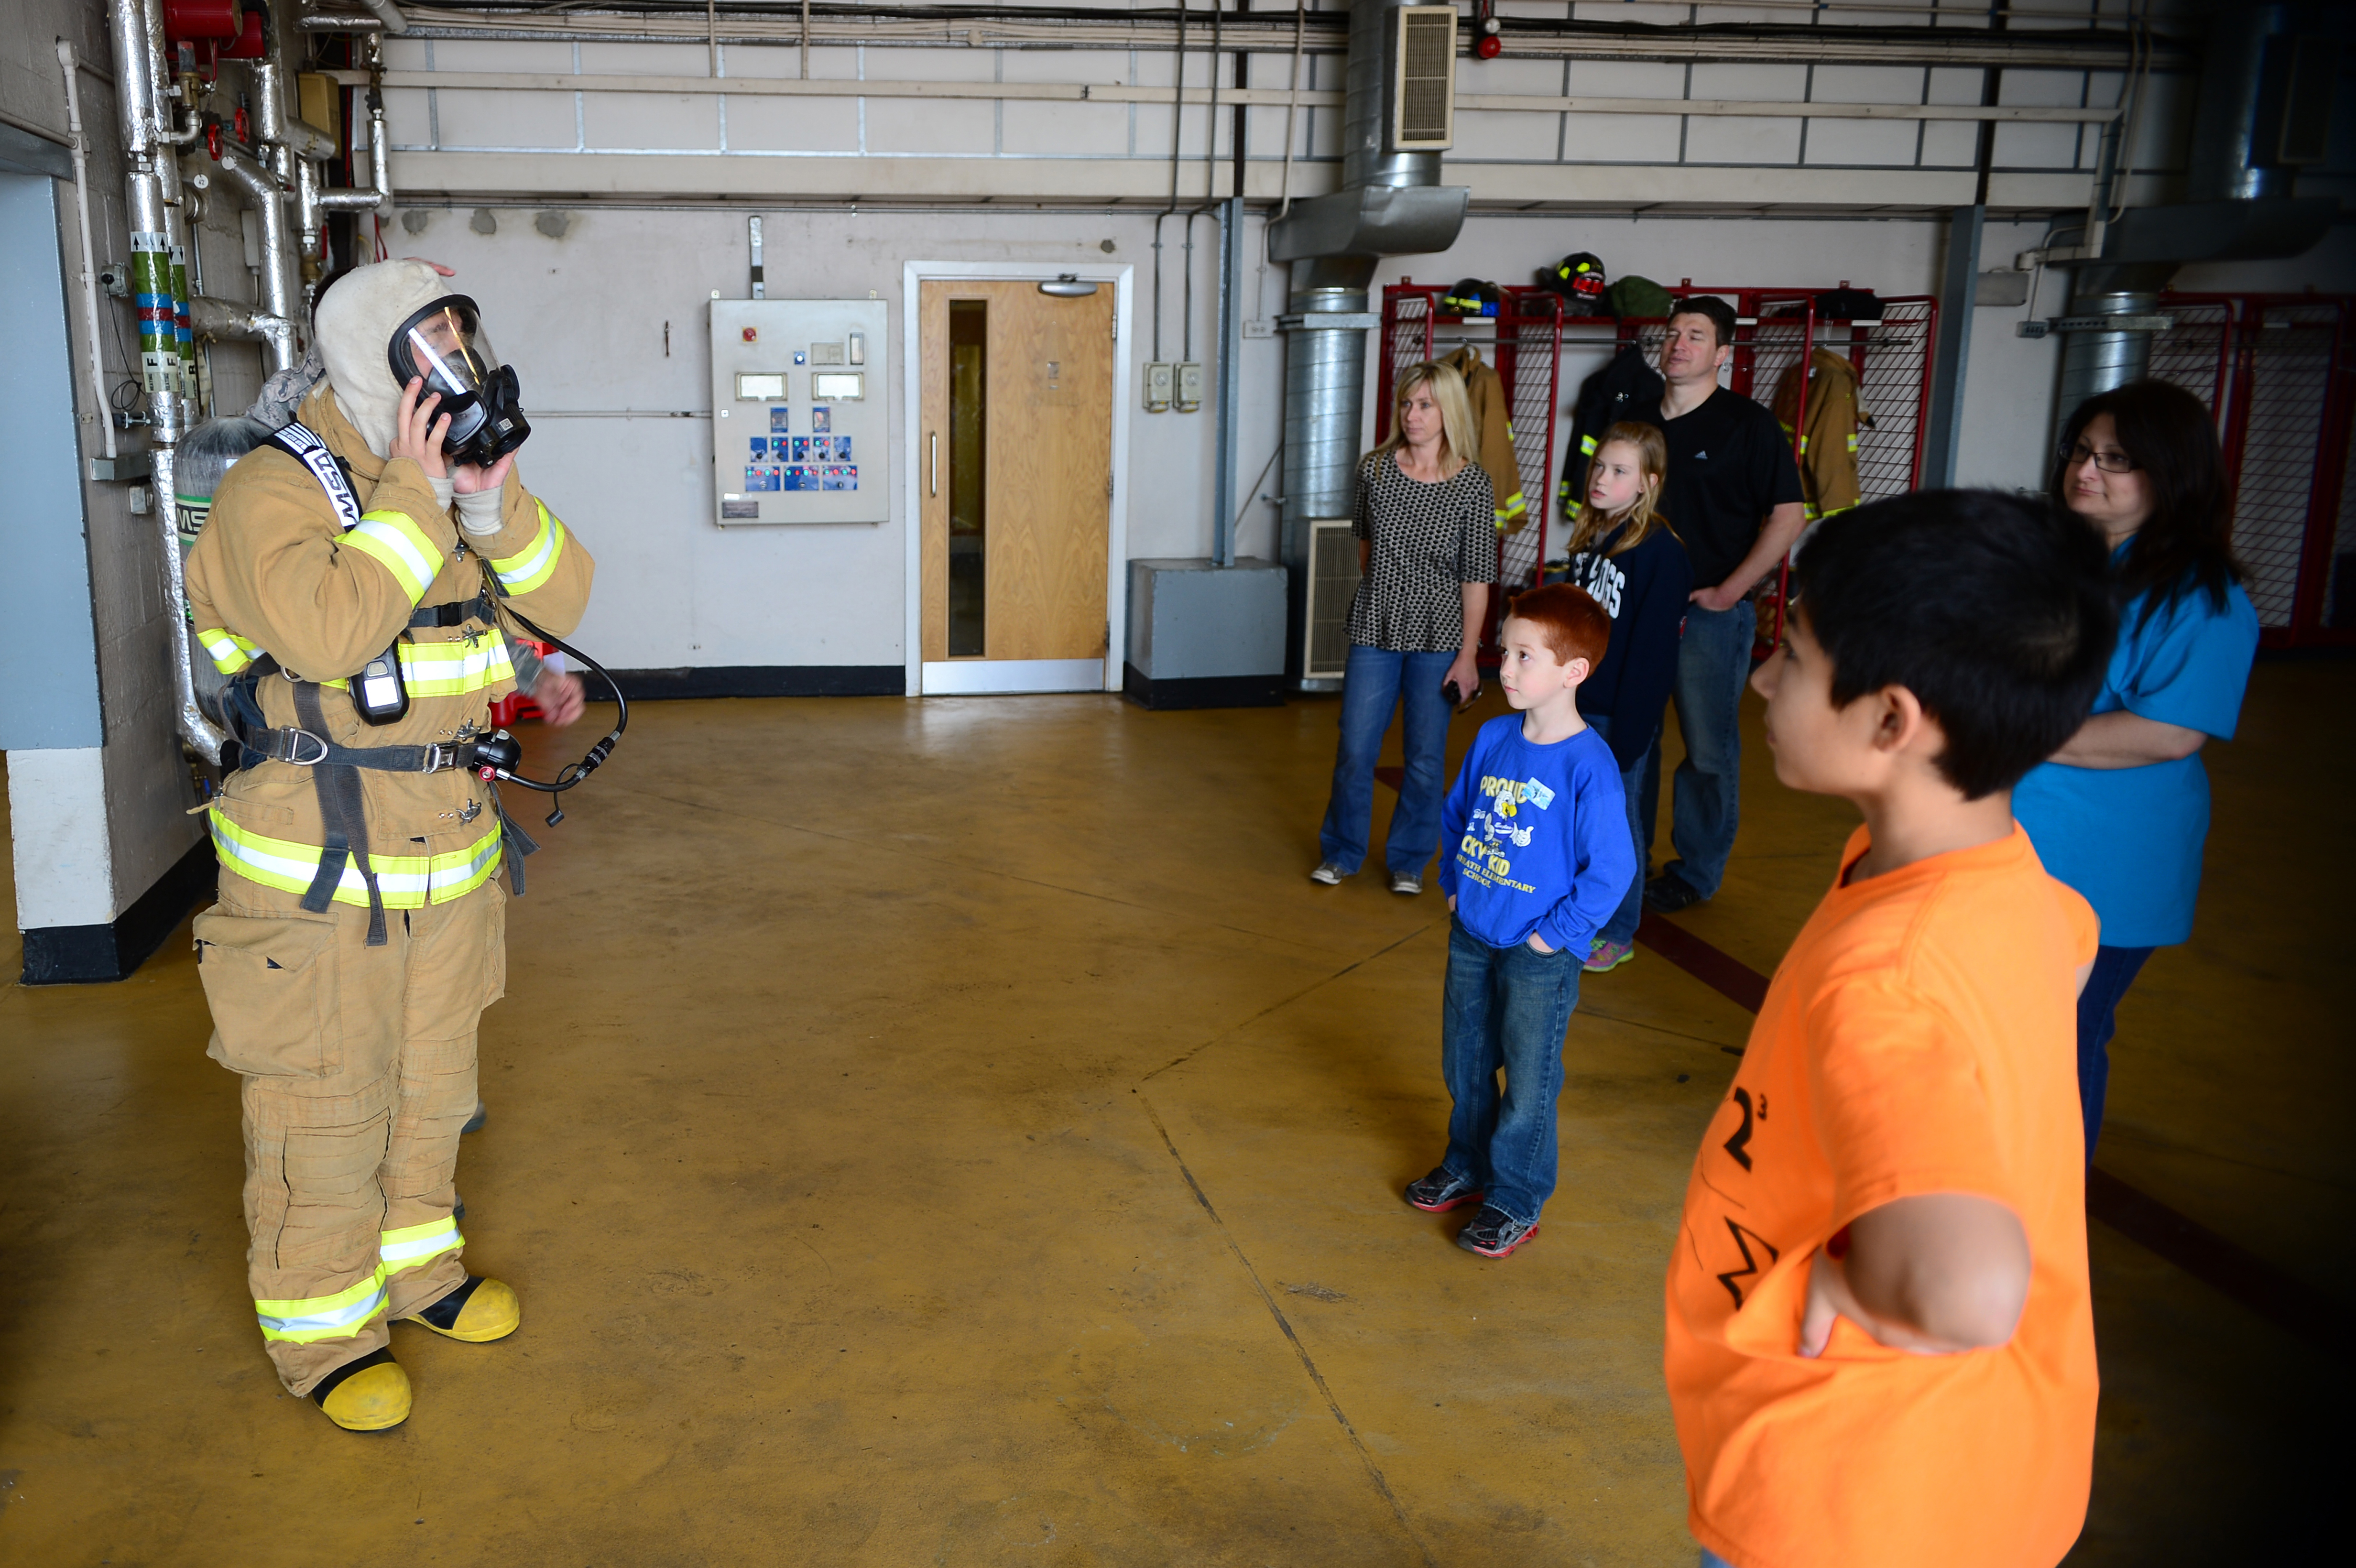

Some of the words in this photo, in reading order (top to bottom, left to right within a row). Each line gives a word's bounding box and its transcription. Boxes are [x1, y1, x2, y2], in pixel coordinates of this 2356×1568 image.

[147, 358, 158, 366] F
[166, 358, 176, 366] F
[313, 451, 359, 524] MSA
[1479, 775, 1528, 804] PROUD
[1488, 854, 1511, 877] KID
[1462, 868, 1491, 888] SCHOOL
[1481, 868, 1536, 893] ELEMENTARY
